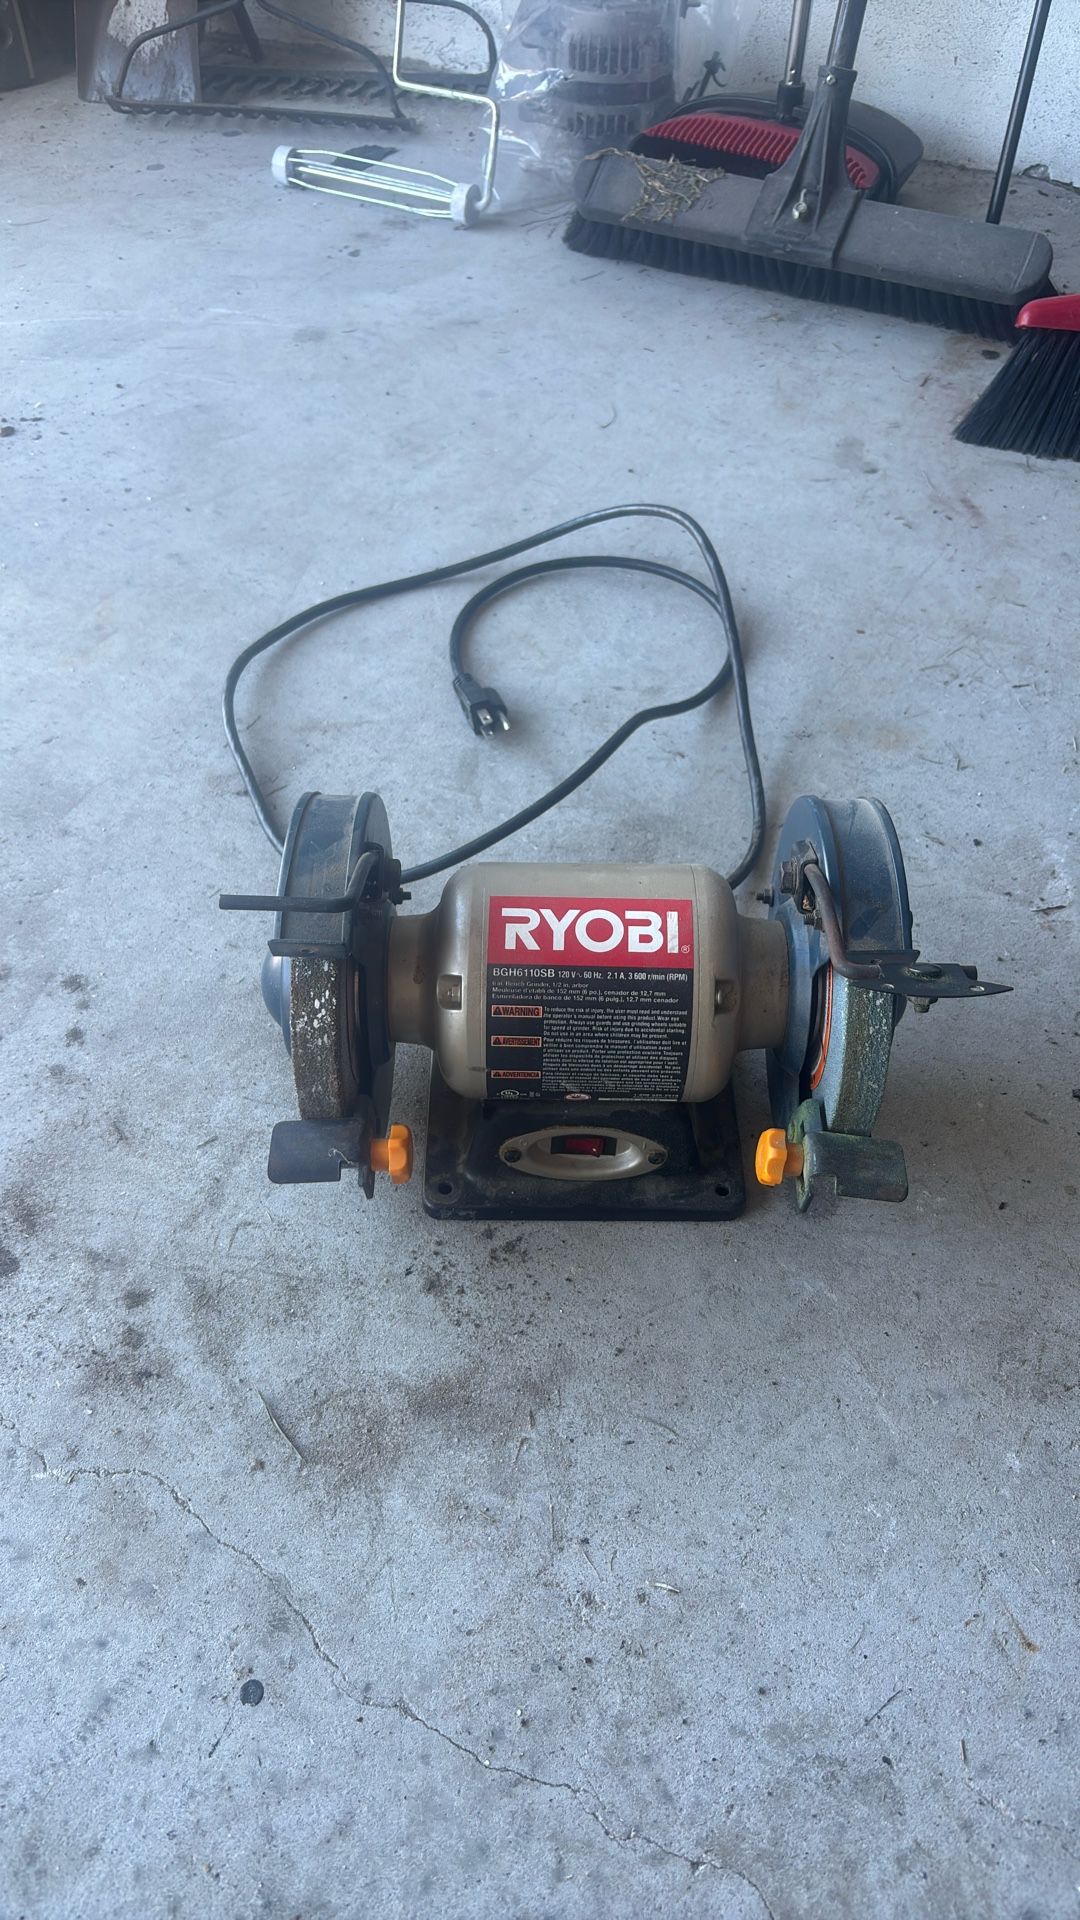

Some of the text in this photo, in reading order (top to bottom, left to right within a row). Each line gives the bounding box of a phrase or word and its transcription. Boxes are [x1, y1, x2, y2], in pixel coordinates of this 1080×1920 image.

[501, 907, 678, 953] RYOBI
[492, 967, 555, 978] BGH6110SB
[583, 971, 592, 979] 60
[666, 973, 688, 982] (RPM)
[502, 1006, 539, 1016] WARNING
